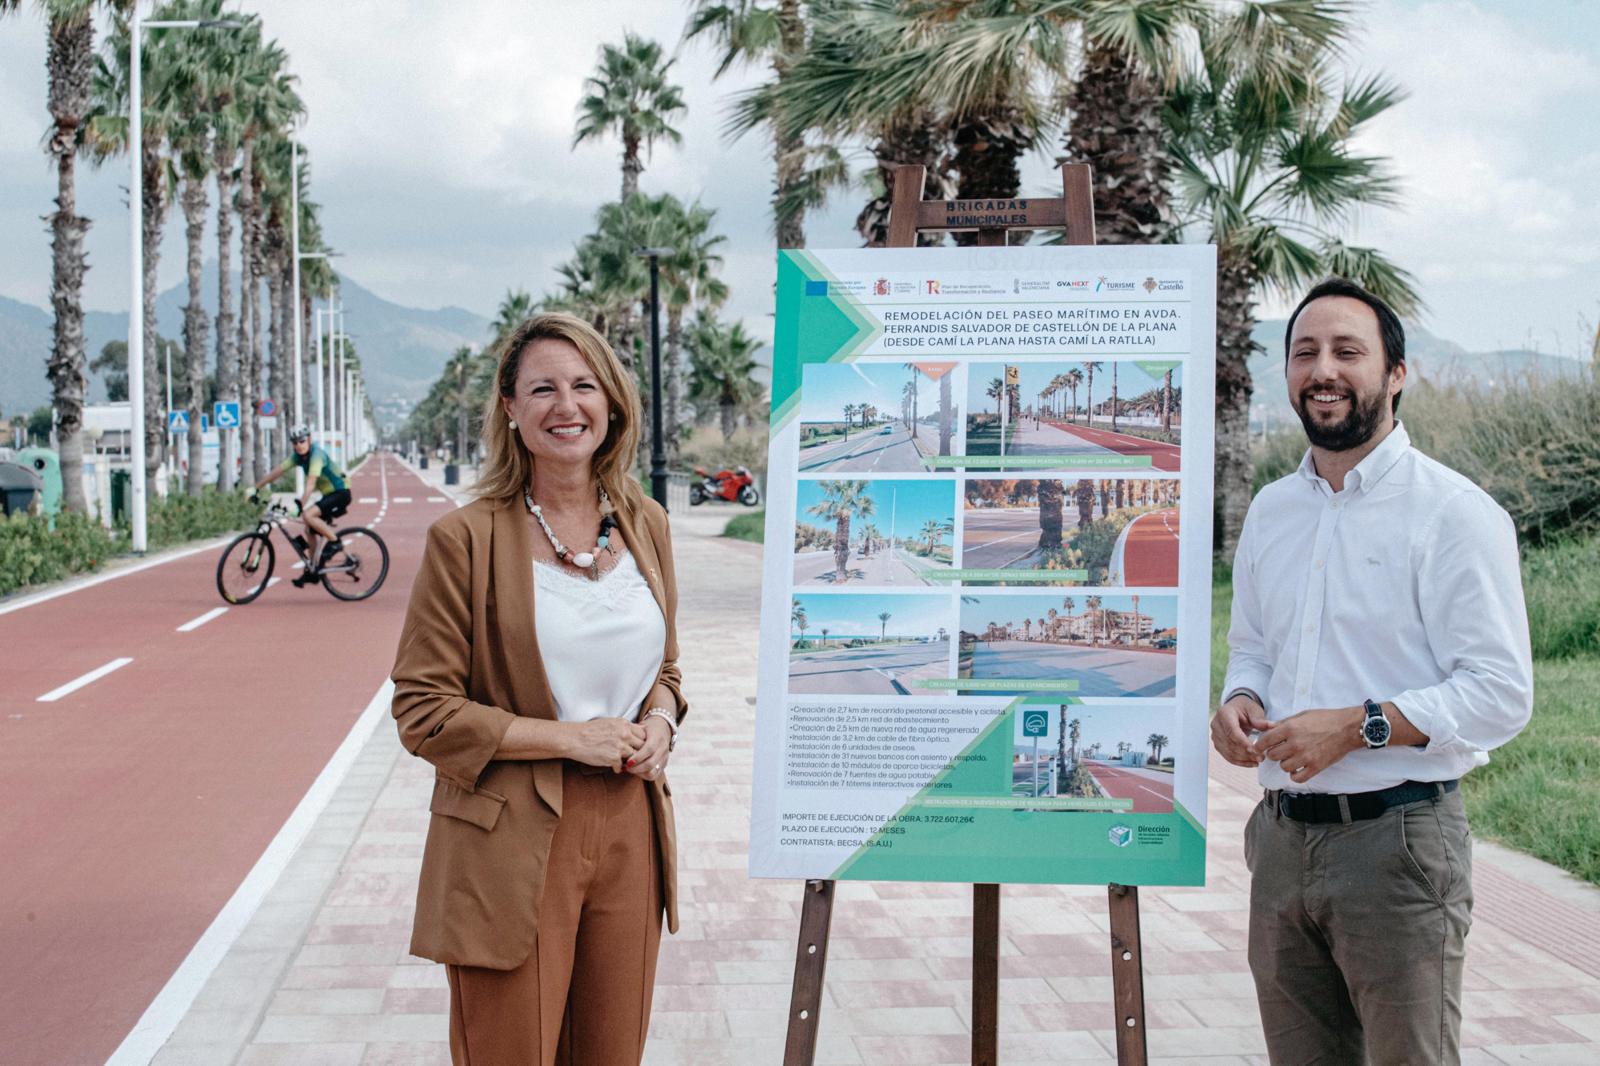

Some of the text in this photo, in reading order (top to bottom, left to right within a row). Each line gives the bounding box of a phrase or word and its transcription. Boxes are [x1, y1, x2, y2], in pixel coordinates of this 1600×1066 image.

[946, 200, 1027, 211] BRIGADAS
[946, 214, 1027, 225] MUNICIPALES
[884, 308, 1182, 321] REMODELACIÓN DEL PASEO MARÍTIMO EN AVDA.
[884, 321, 1177, 334] FERRANDIS SALVADOR DE CASTELLÓN DE LA PLANA
[883, 334, 1156, 348] (DESDE CAMÍ LA PLANA HASTA CAMÍ LA RATLLA)
[793, 705, 826, 714] Creación
[849, 706, 859, 714] km
[861, 706, 870, 714] de
[793, 715, 835, 723] Renovación
[836, 715, 845, 723] de
[792, 724, 826, 732] Creación
[791, 752, 830, 760] Instalación
[878, 753, 905, 761] bancos
[791, 761, 830, 769] Instalación
[851, 761, 881, 769] módulos
[790, 770, 832, 778] Renovación
[790, 779, 829, 787] Instalación
[873, 780, 914, 788] interactivos
[782, 813, 817, 821] IMPORTE
[829, 813, 874, 822] EJECUCIÓN
[875, 814, 886, 822] DE
[887, 814, 897, 822] LA
[782, 825, 807, 833] PLAZO
[808, 825, 820, 833] DE
[820, 825, 865, 834] EJECUCIÓN
[879, 826, 906, 834] MESES
[1138, 825, 1170, 833] Dirección
[780, 838, 836, 847] CONTRATISTA:
